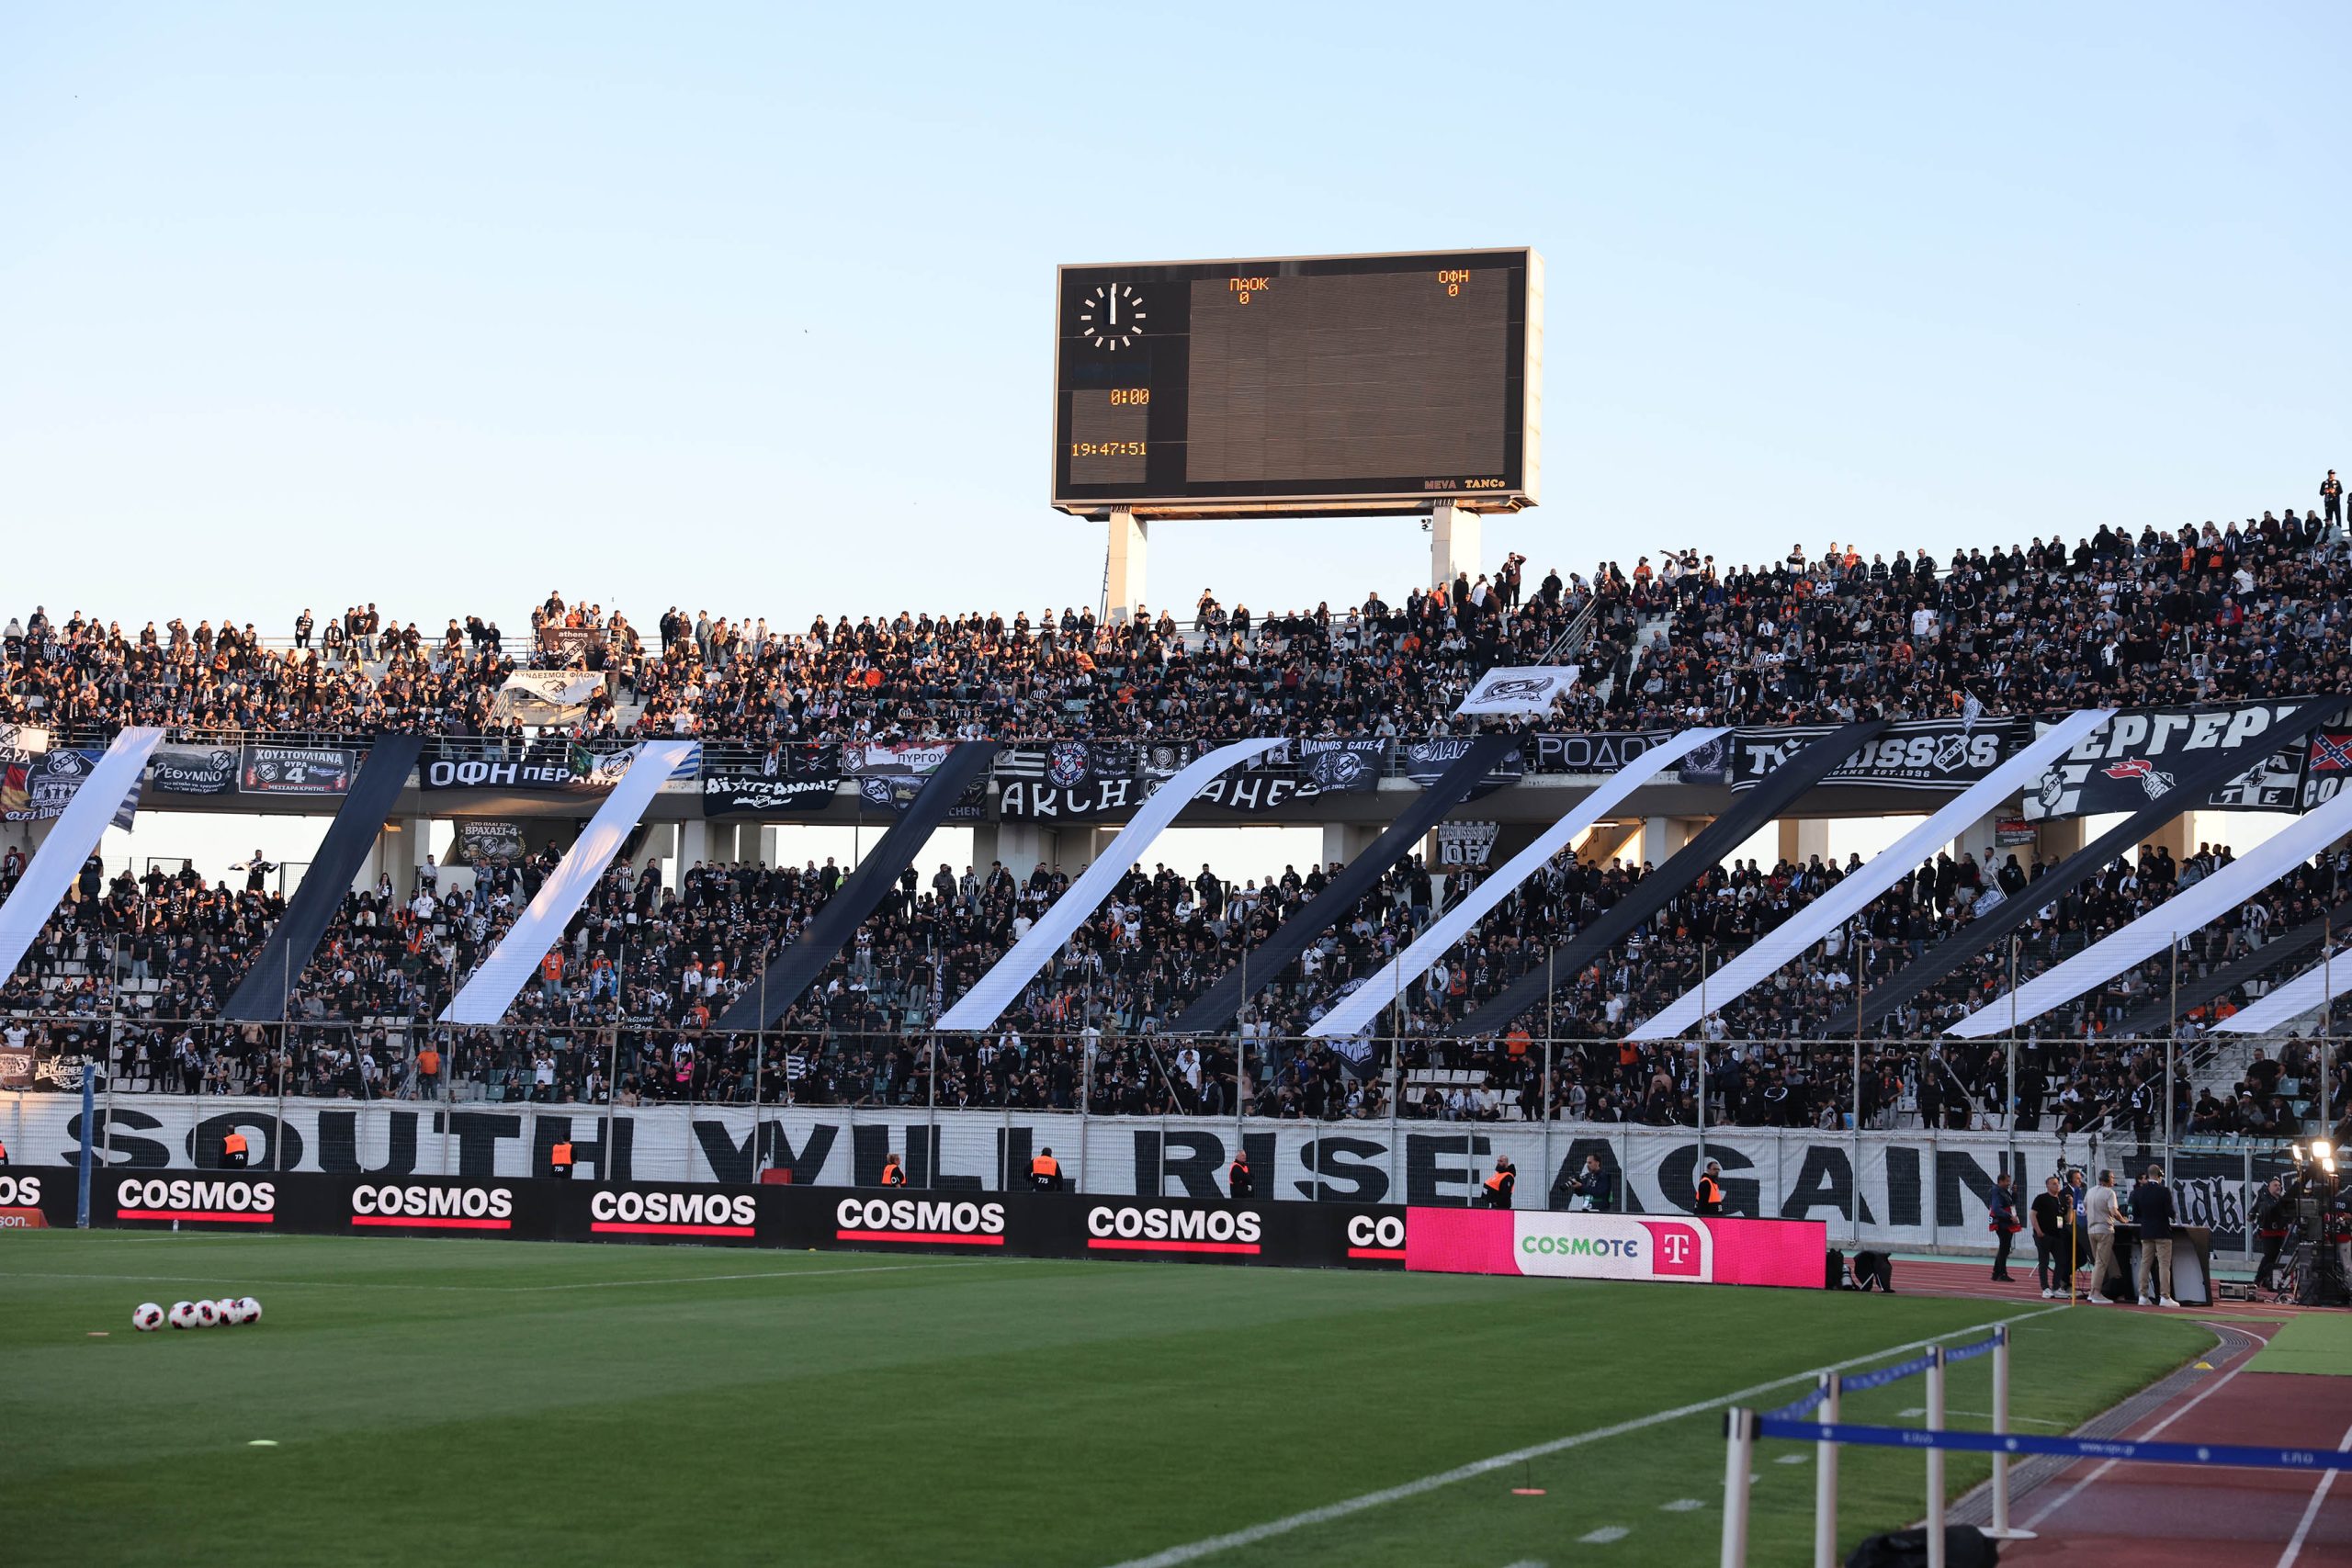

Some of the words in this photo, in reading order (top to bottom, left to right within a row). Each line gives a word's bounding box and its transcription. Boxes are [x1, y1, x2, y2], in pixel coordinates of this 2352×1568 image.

[1230, 277, 1269, 291] ΠΑΟΚ
[1439, 270, 1469, 283] ΟΦΗ
[1239, 292, 1250, 304] 0
[1449, 284, 1458, 297] 0
[1111, 389, 1149, 405] 0:00
[1072, 443, 1147, 457] 19:47:51
[1425, 480, 1456, 489] MEVA
[1301, 739, 1342, 757] VIANNOS
[1347, 740, 1375, 750] GATE
[1374, 738, 1386, 755] 4
[285, 768, 305, 784] 4
[431, 761, 518, 786] ΟΦΗ
[62, 1108, 633, 1181] SOUTH
[694, 1120, 1077, 1192] WILL
[1134, 1131, 1491, 1207] RISE
[1549, 1138, 2027, 1227] AGAIN
[117, 1179, 275, 1213] COSMOS
[352, 1184, 512, 1218] COSMOS
[592, 1190, 756, 1225] COSMOS
[837, 1198, 1005, 1234] COSMOS
[1088, 1206, 1261, 1243] COSMOS
[1521, 1235, 1638, 1258] COSMOTE
[1664, 1234, 1690, 1264] T
